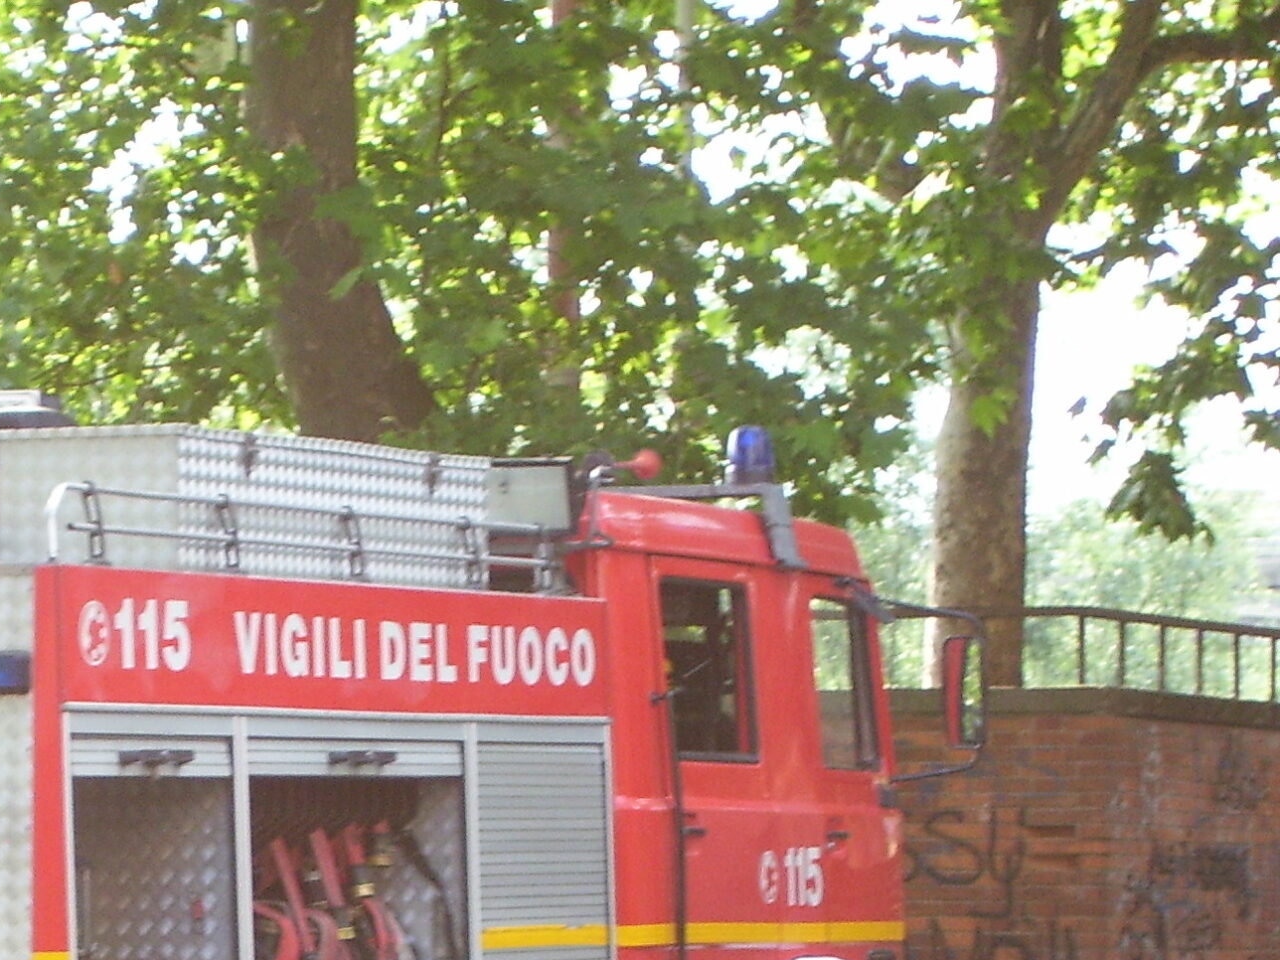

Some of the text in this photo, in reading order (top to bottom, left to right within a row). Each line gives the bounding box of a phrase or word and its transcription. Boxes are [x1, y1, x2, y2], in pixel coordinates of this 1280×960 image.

[113, 598, 597, 687] 115 VIGILI DEL FUOCO
[783, 847, 824, 907] 115
